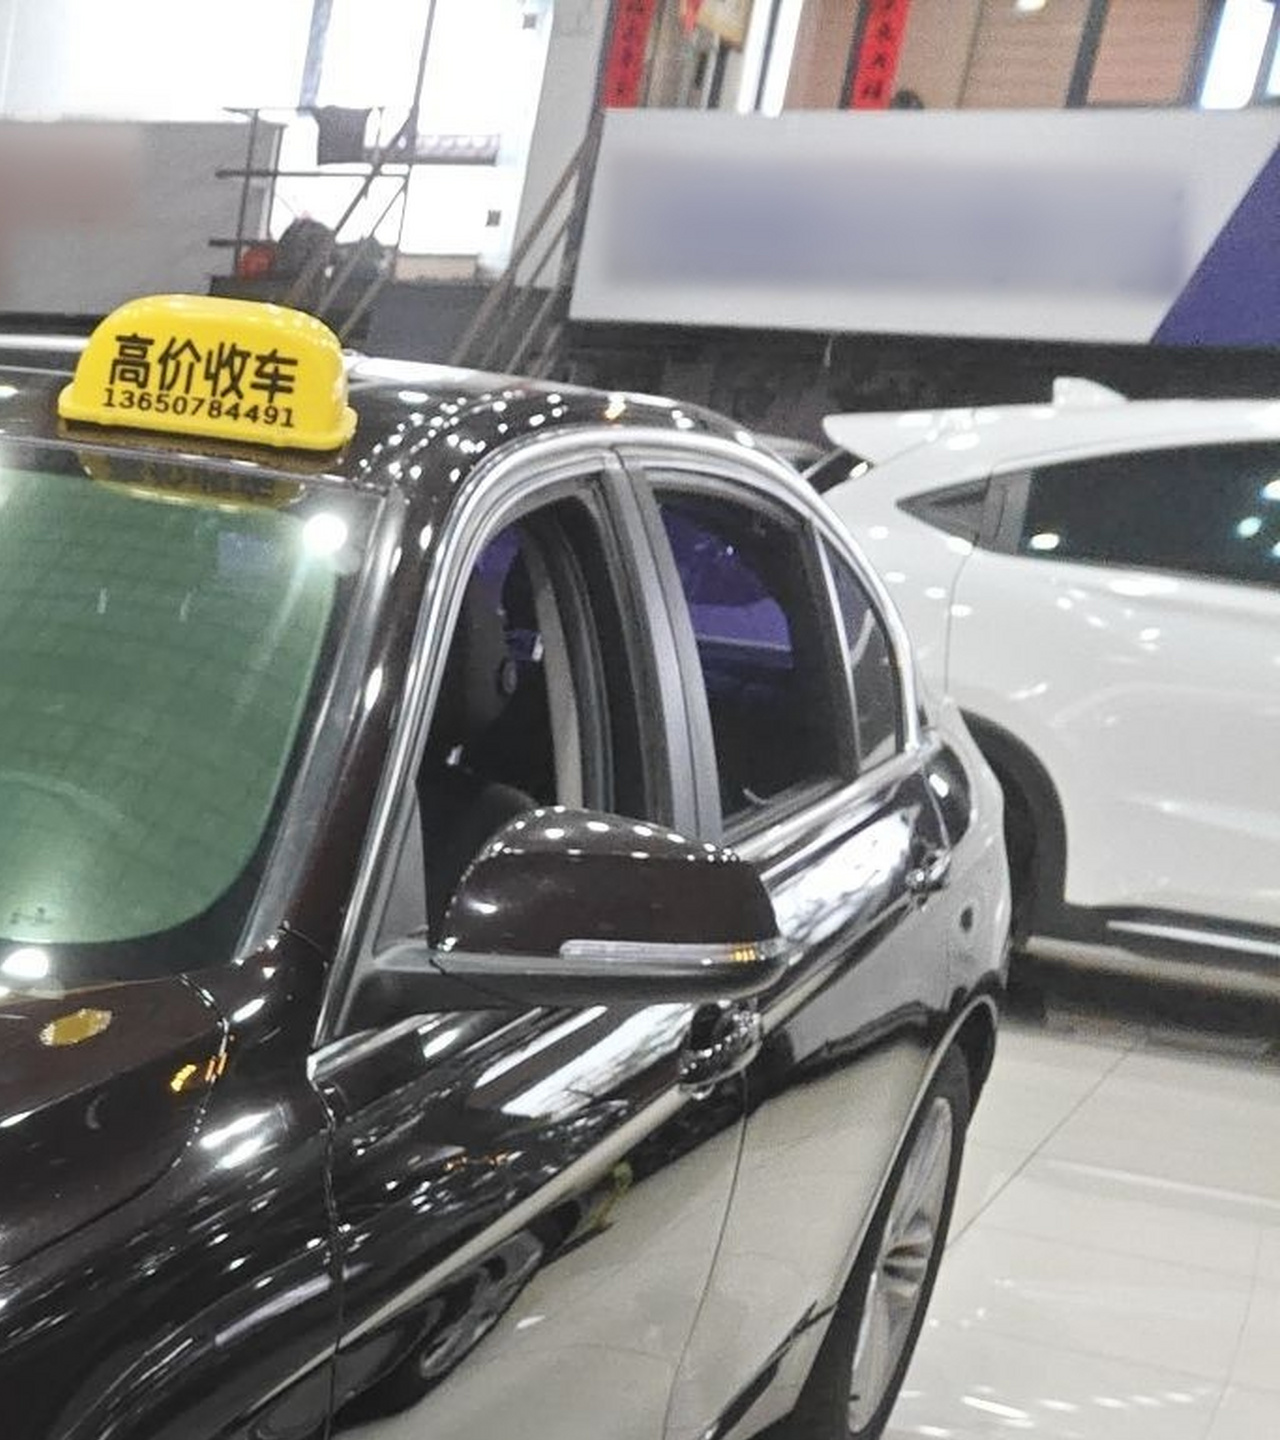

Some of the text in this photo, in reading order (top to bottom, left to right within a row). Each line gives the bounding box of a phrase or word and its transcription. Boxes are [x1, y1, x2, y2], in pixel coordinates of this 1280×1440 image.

[109, 333, 299, 405] 高价收车
[102, 387, 295, 428] 13650784491
